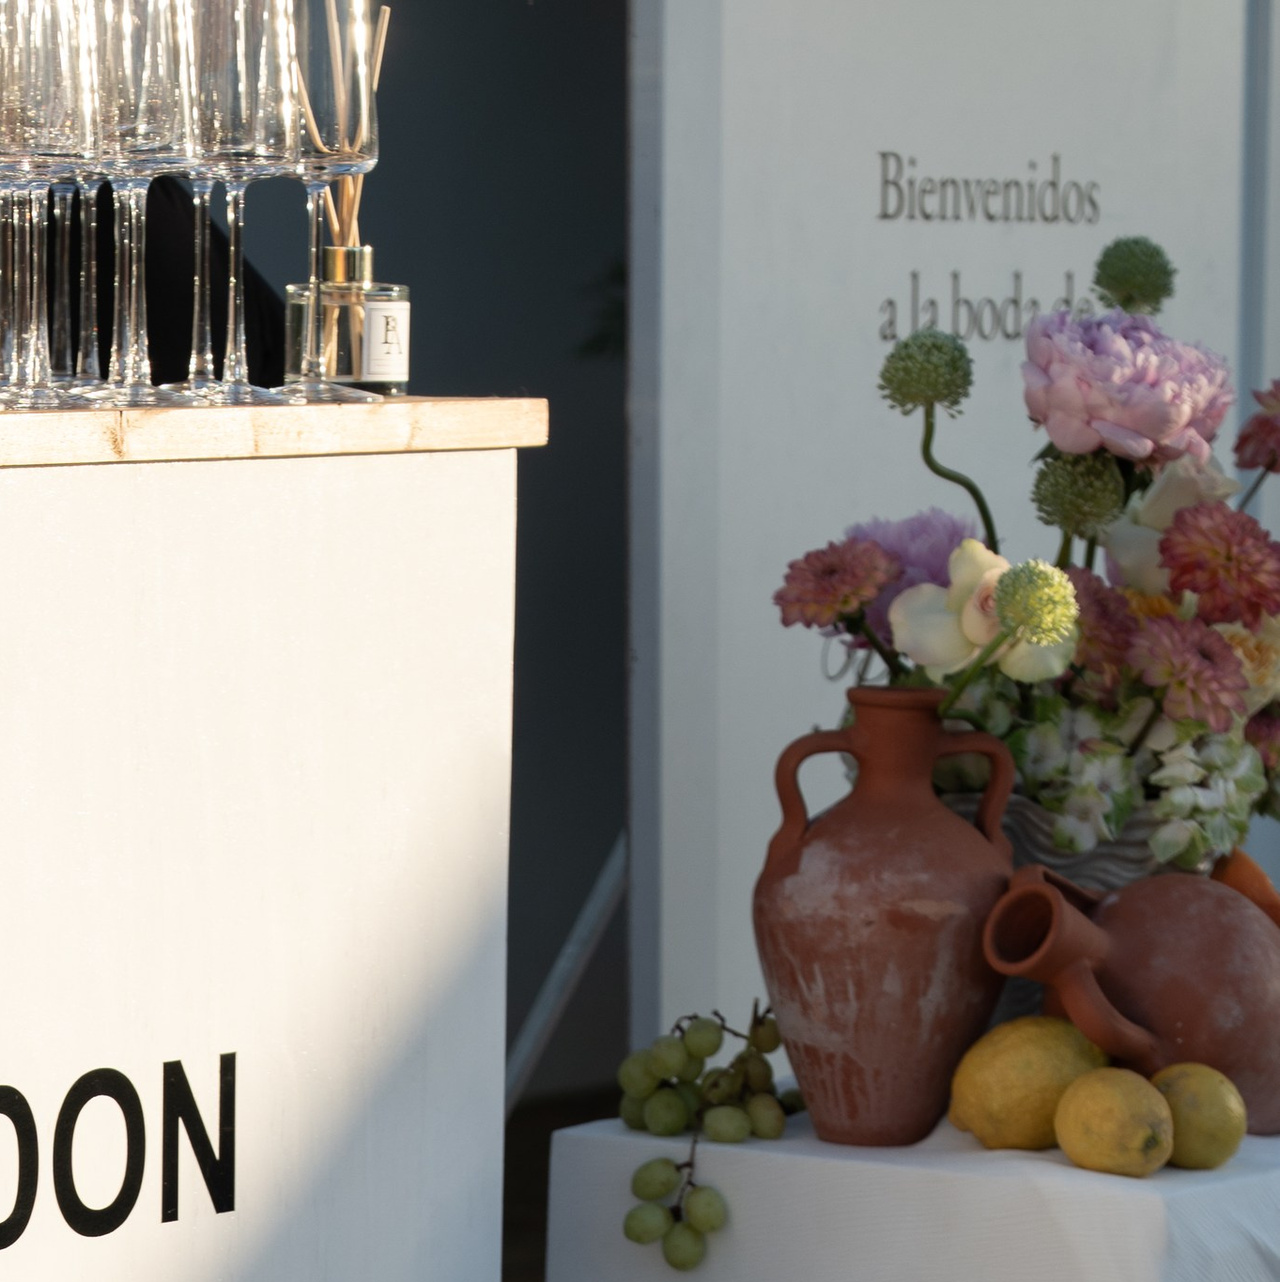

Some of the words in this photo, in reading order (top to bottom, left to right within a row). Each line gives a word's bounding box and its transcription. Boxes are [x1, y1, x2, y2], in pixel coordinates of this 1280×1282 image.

[876, 150, 1101, 225] Bienvenidos
[878, 297, 898, 341] a
[910, 269, 938, 335] la
